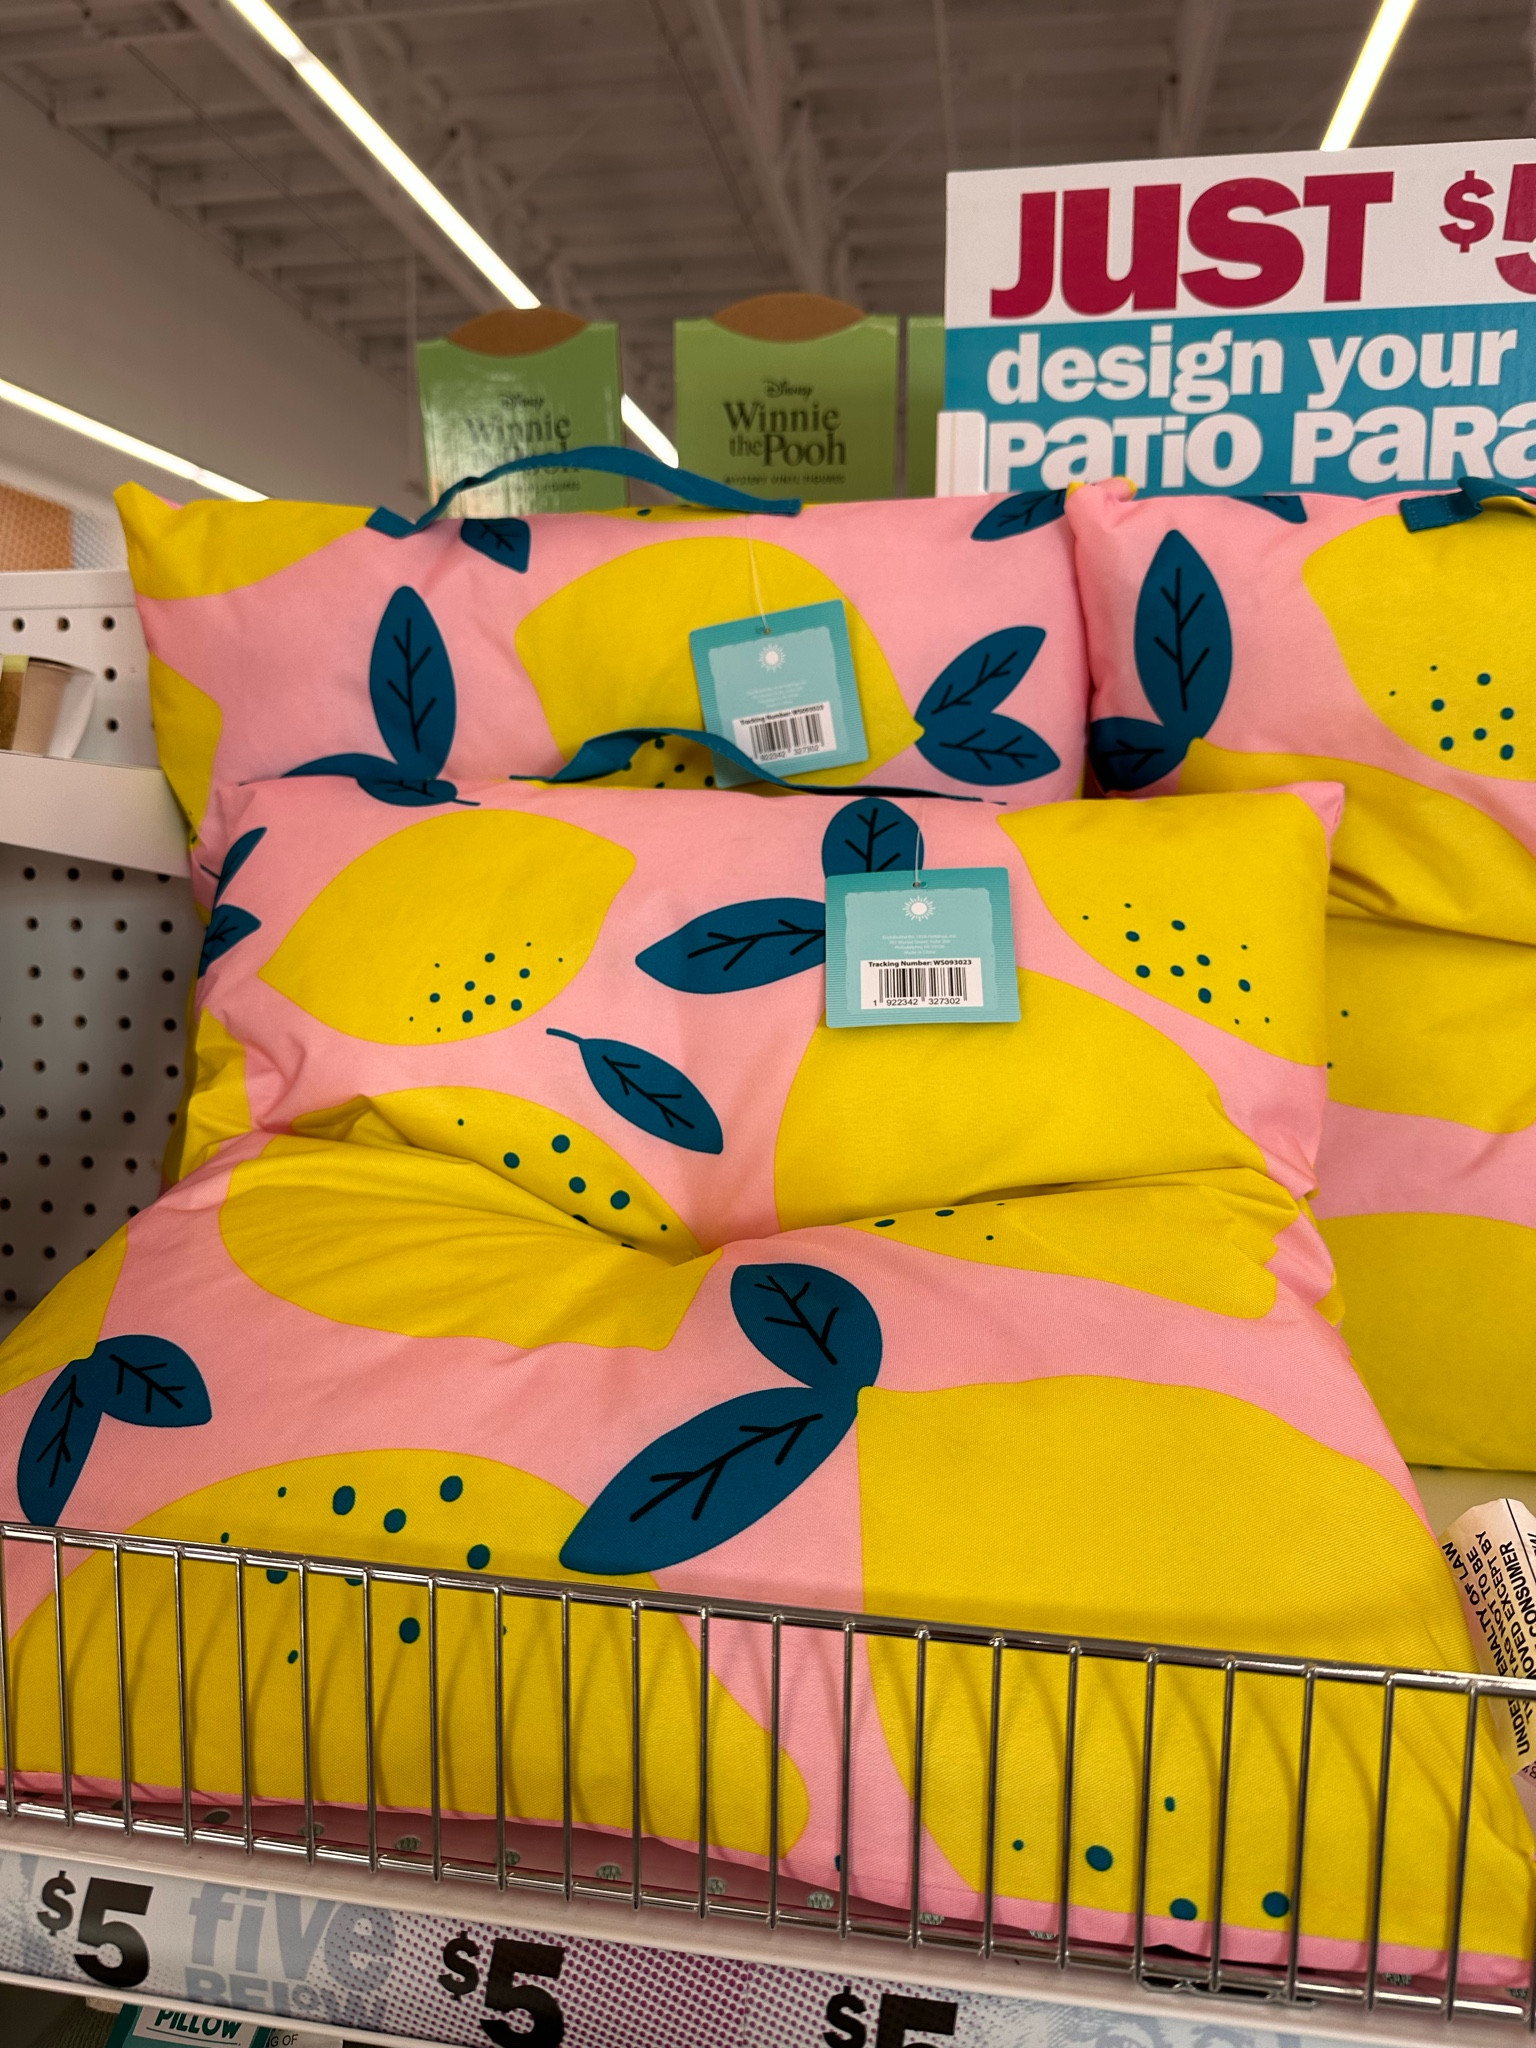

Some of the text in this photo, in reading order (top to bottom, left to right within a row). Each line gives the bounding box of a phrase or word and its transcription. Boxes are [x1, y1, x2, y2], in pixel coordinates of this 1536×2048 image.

[986, 325, 1518, 413] design your
[722, 401, 842, 433] Winnie
[729, 432, 847, 467] the Pooh
[886, 998, 918, 1006] 922342
[928, 997, 961, 1005] 327302
[1442, 1541, 1469, 1580] LAW
[1466, 1546, 1483, 1575] BE
[1475, 1531, 1492, 1556] BY
[1464, 1583, 1480, 1606] OF
[1478, 1573, 1491, 1600] TO
[1487, 1555, 1515, 1622] EXCEPT
[1488, 1599, 1506, 1638] NOT
[1475, 1608, 1508, 1677] ENALTY
[37, 1870, 154, 1988] $5
[189, 1882, 397, 1992] five
[437, 1929, 567, 2048] $5
[153, 2007, 244, 2039] PILLOW
[282, 2033, 299, 2047] OF
